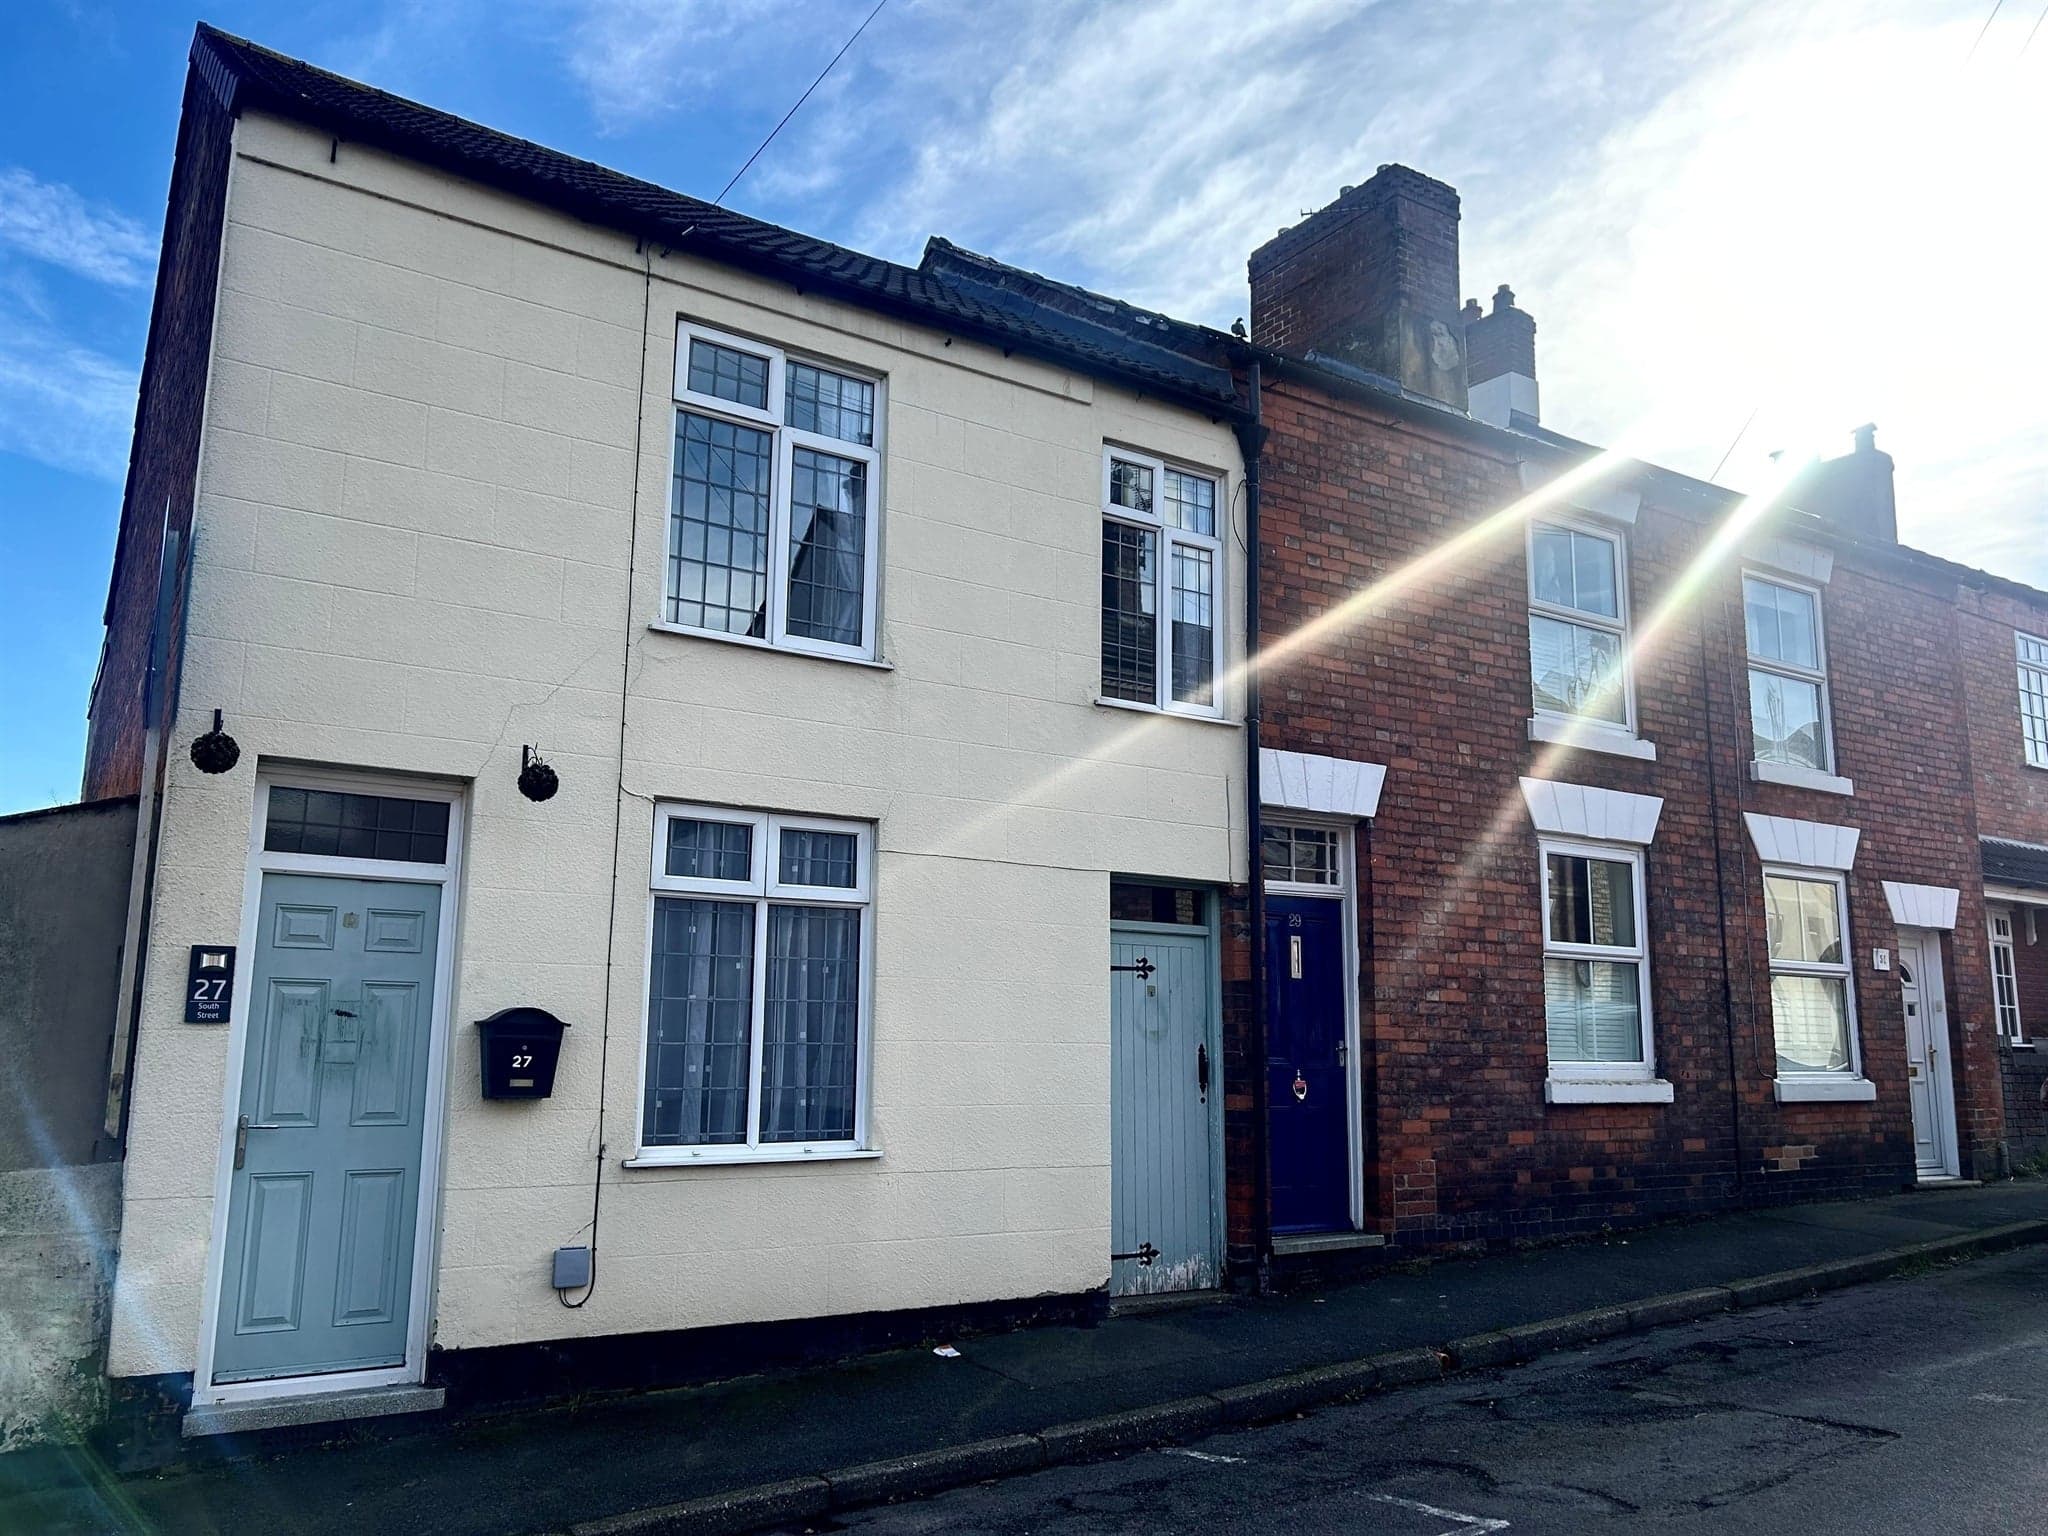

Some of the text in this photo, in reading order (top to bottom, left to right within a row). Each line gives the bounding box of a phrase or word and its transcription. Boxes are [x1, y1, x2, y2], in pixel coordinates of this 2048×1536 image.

[1289, 913, 1301, 927] 29
[194, 979, 226, 1000] 27
[198, 1002, 220, 1010] South
[197, 1011, 219, 1019] Street
[512, 1055, 532, 1068] 27
